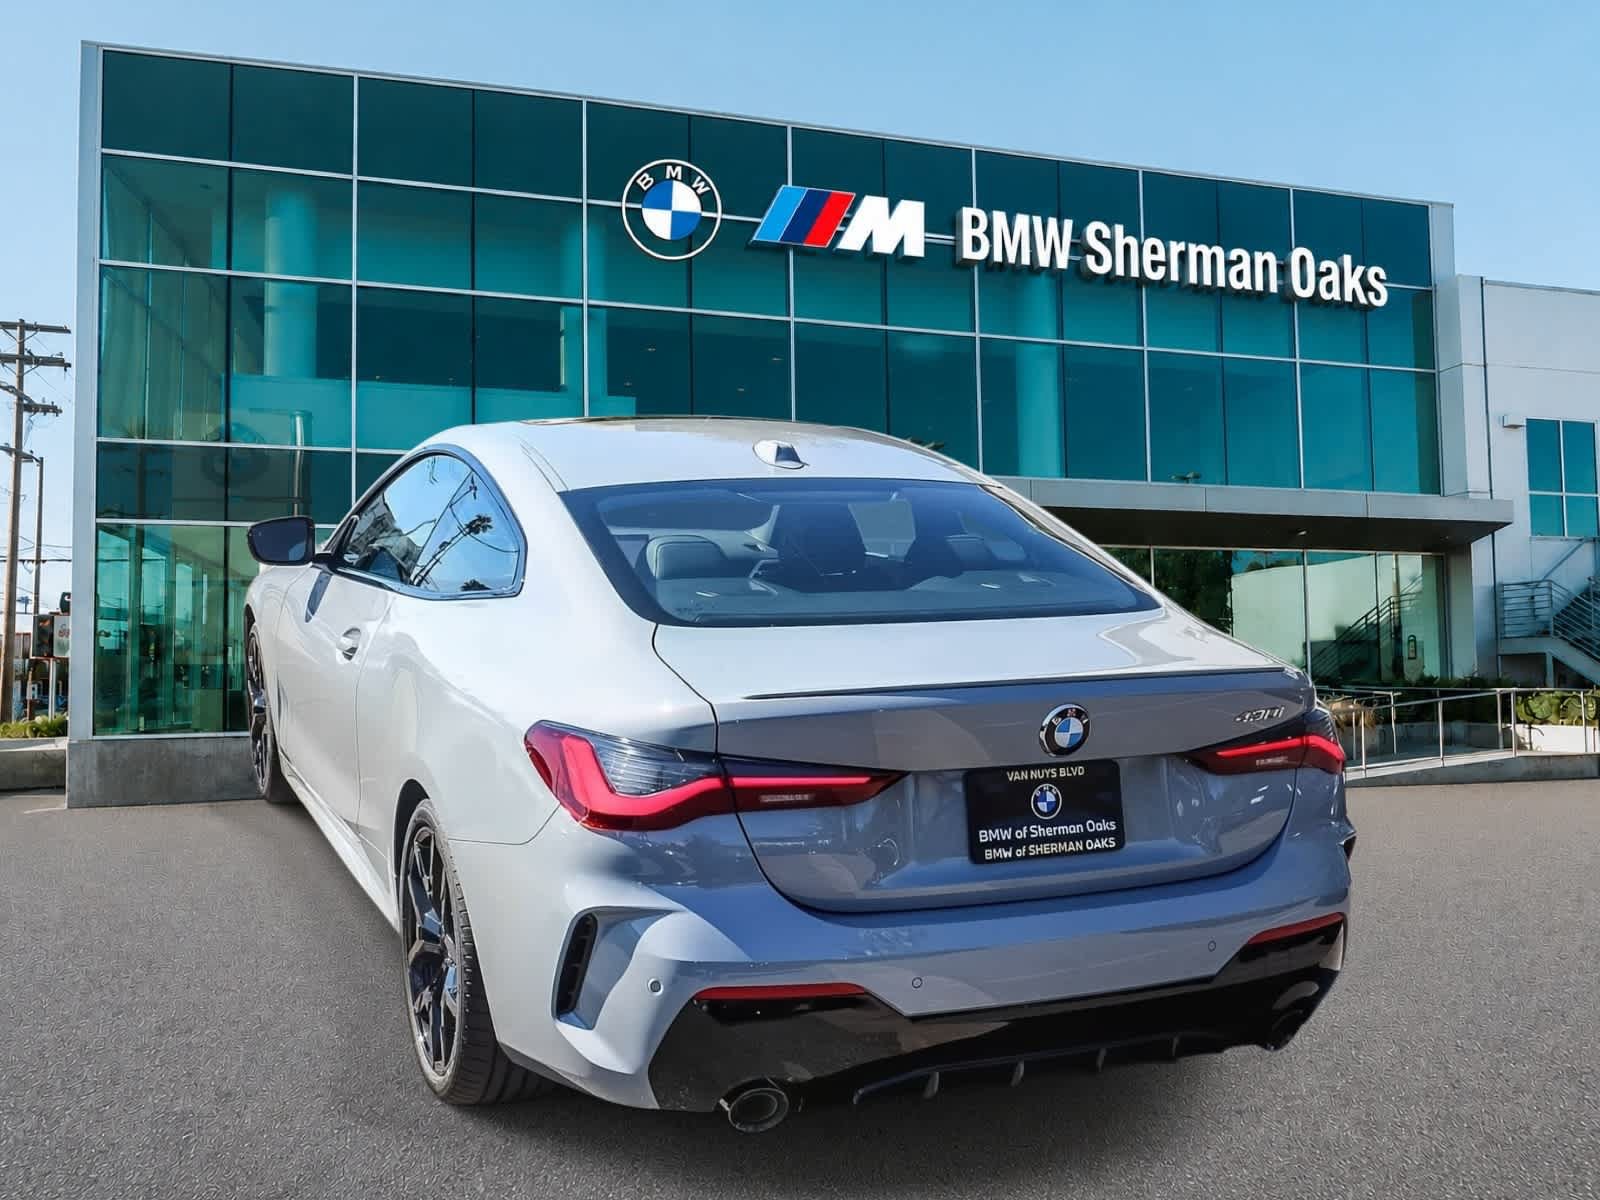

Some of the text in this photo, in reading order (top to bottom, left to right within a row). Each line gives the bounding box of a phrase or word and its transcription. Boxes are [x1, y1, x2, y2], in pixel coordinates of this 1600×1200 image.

[636, 165, 711, 196] BMW
[961, 206, 1389, 308] BMW Sherman Oaks
[1007, 766, 1085, 782] VAN NUYS BLVD
[979, 819, 1116, 842] BMW of Sherman Oaks
[984, 837, 1116, 860] BMW of SHERMAN OAKS
